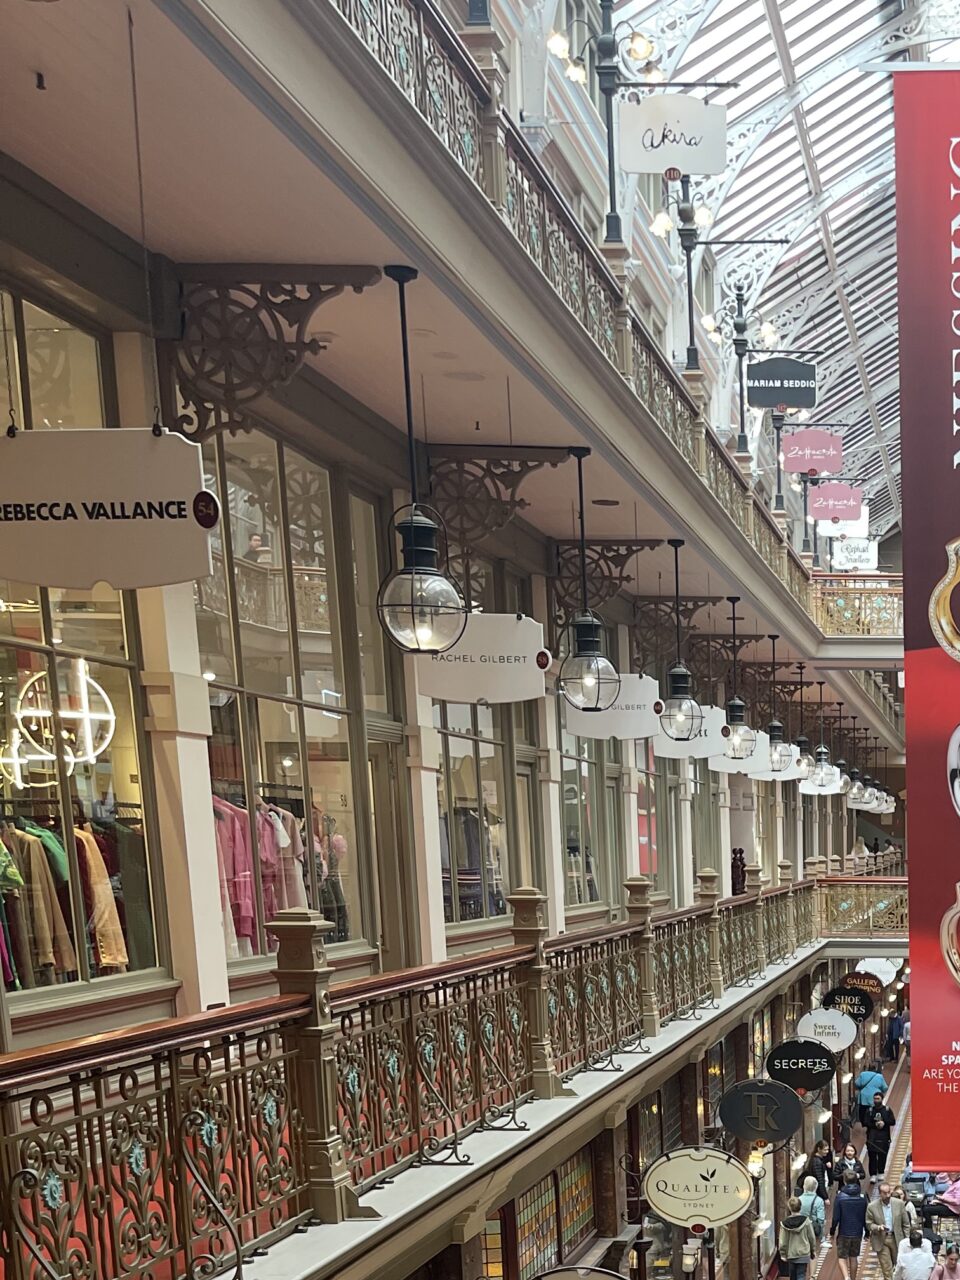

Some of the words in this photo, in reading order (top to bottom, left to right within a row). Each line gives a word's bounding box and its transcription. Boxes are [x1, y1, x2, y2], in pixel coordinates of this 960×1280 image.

[641, 120, 703, 152] akira
[666, 170, 680, 179] 110
[747, 379, 781, 388] MARIAM
[82, 501, 187, 519] VALLANCE
[198, 502, 215, 517] 54
[432, 654, 476, 662] RACHEL
[480, 655, 528, 663] GILBERT
[611, 703, 647, 711] GILBERT
[847, 978, 878, 986] GALLERY
[834, 994, 862, 1004] SHOE
[813, 1029, 841, 1038] Infinity
[774, 1058, 828, 1069] SECRETS
[923, 1069, 944, 1079] ARE
[937, 1082, 959, 1093] THE
[656, 1179, 741, 1198] QUALITEA
